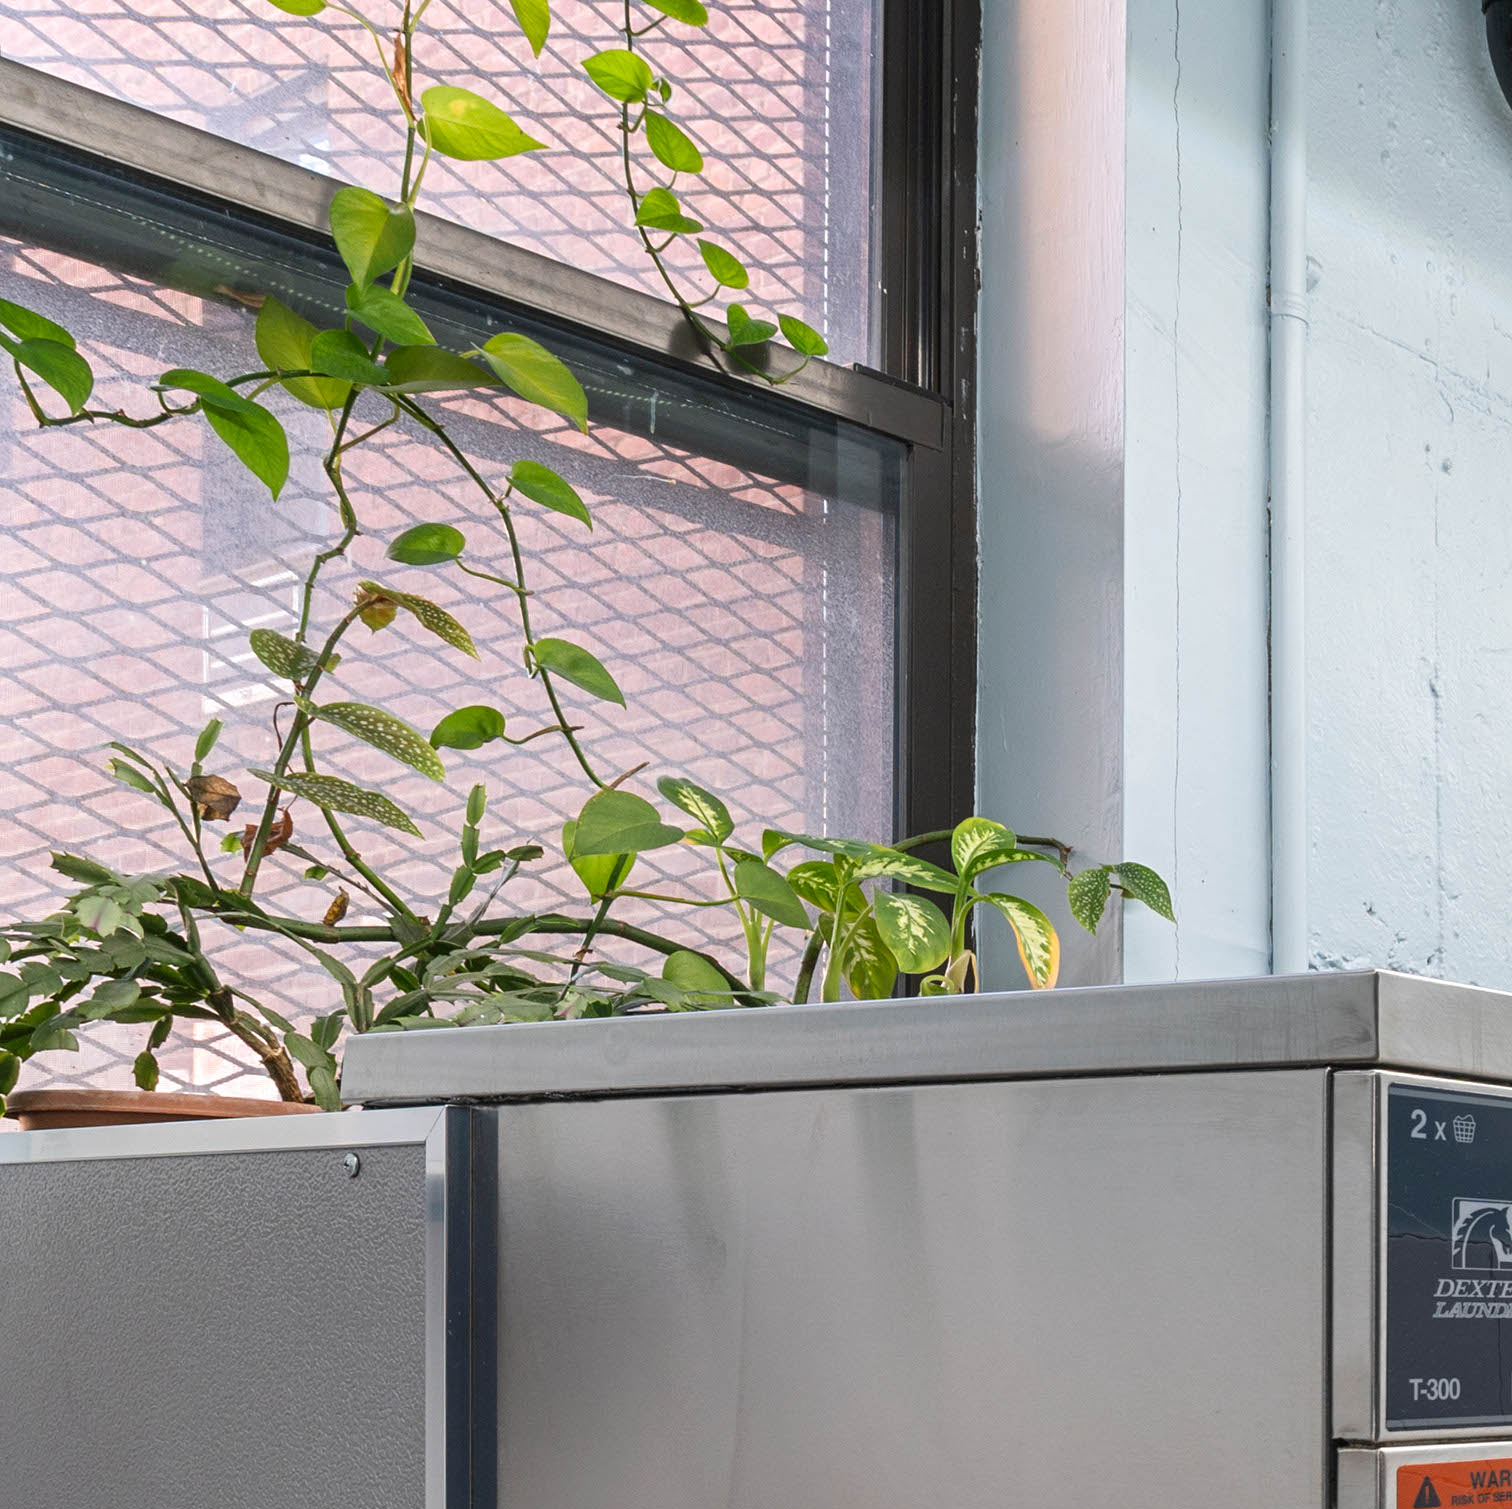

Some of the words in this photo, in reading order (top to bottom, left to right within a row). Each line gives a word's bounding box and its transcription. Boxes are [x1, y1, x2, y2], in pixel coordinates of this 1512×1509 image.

[1410, 1108, 1428, 1140] 2
[1434, 1121, 1448, 1141] x
[1409, 1377, 1462, 1401] T-300
[1451, 1494, 1475, 1506] RISK
[1477, 1492, 1491, 1504] OF
